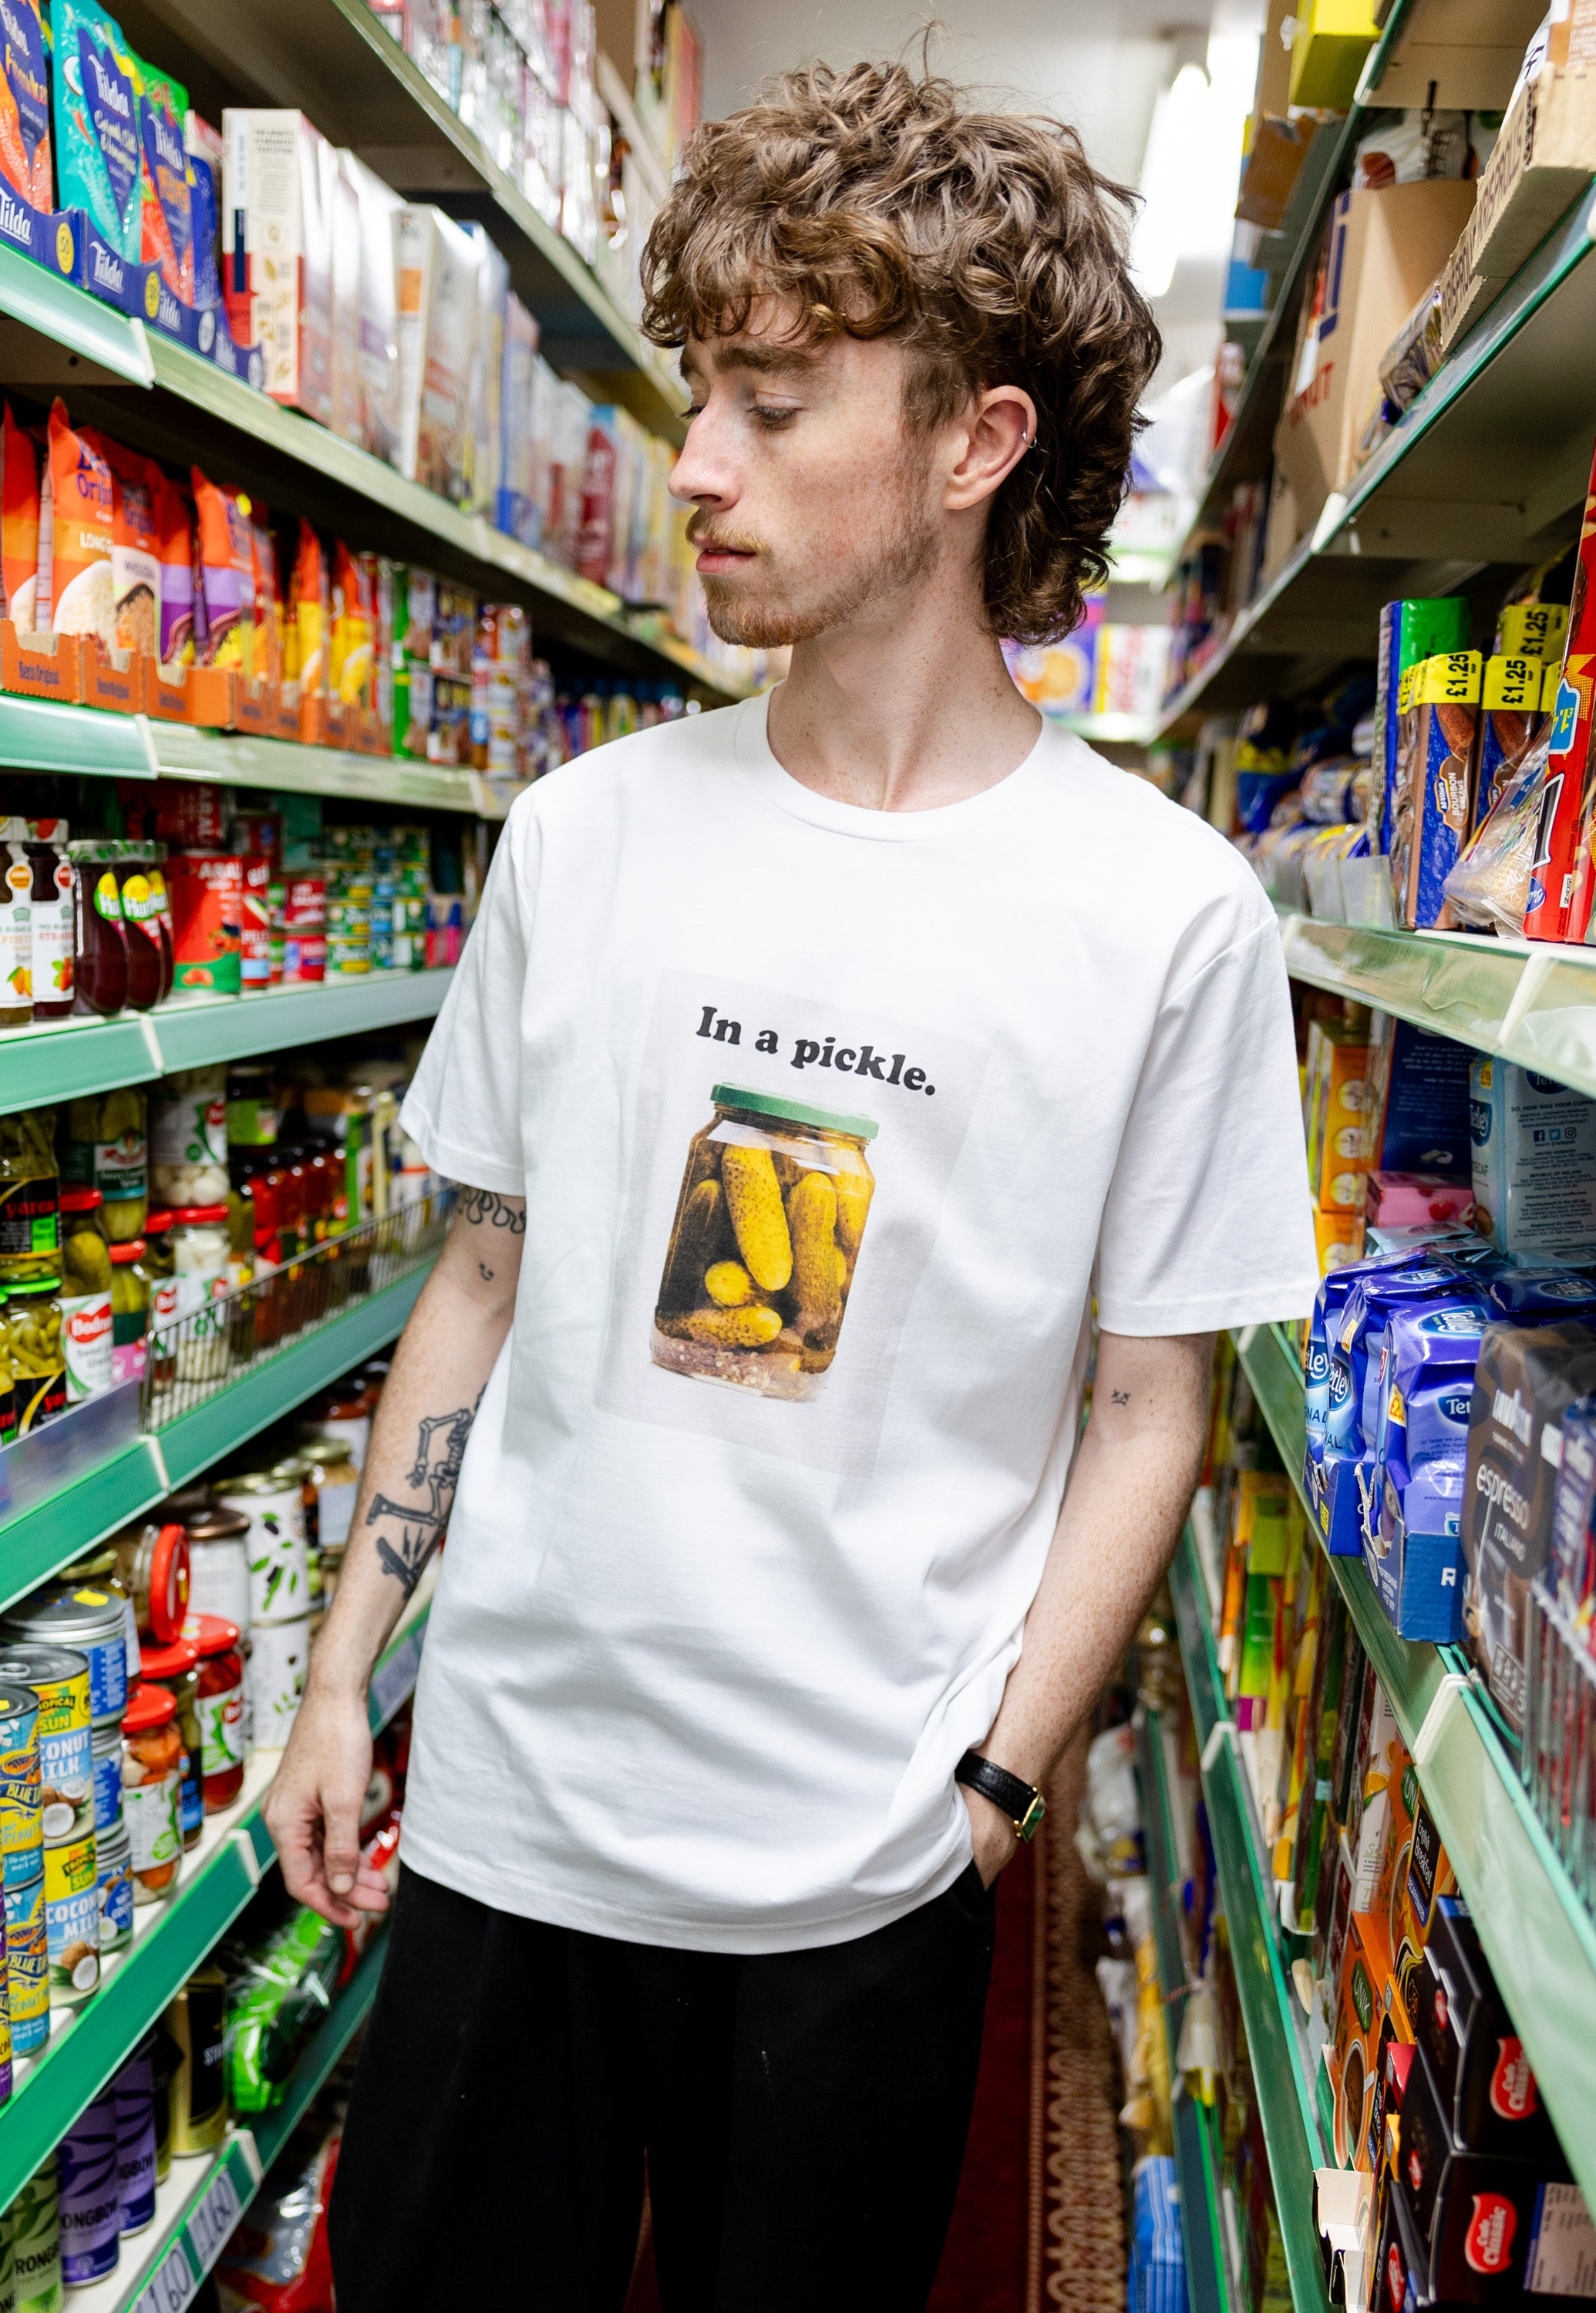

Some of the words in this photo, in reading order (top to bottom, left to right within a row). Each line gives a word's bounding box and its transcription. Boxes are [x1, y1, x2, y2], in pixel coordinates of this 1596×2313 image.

[89, 54, 130, 119] Tilda
[89, 241, 123, 289] Tilda
[1520, 611, 1548, 655] £1.25
[1446, 654, 1470, 696] £1.25
[1502, 660, 1527, 704] £1.25
[1448, 772, 1460, 816] BOURBON
[695, 1006, 742, 1045] In
[755, 1029, 779, 1055] a
[790, 1036, 935, 1096] pickle.
[1446, 1398, 1471, 1415] Tet
[1476, 1463, 1531, 1531] espresso
[1440, 1567, 1456, 1587] R
